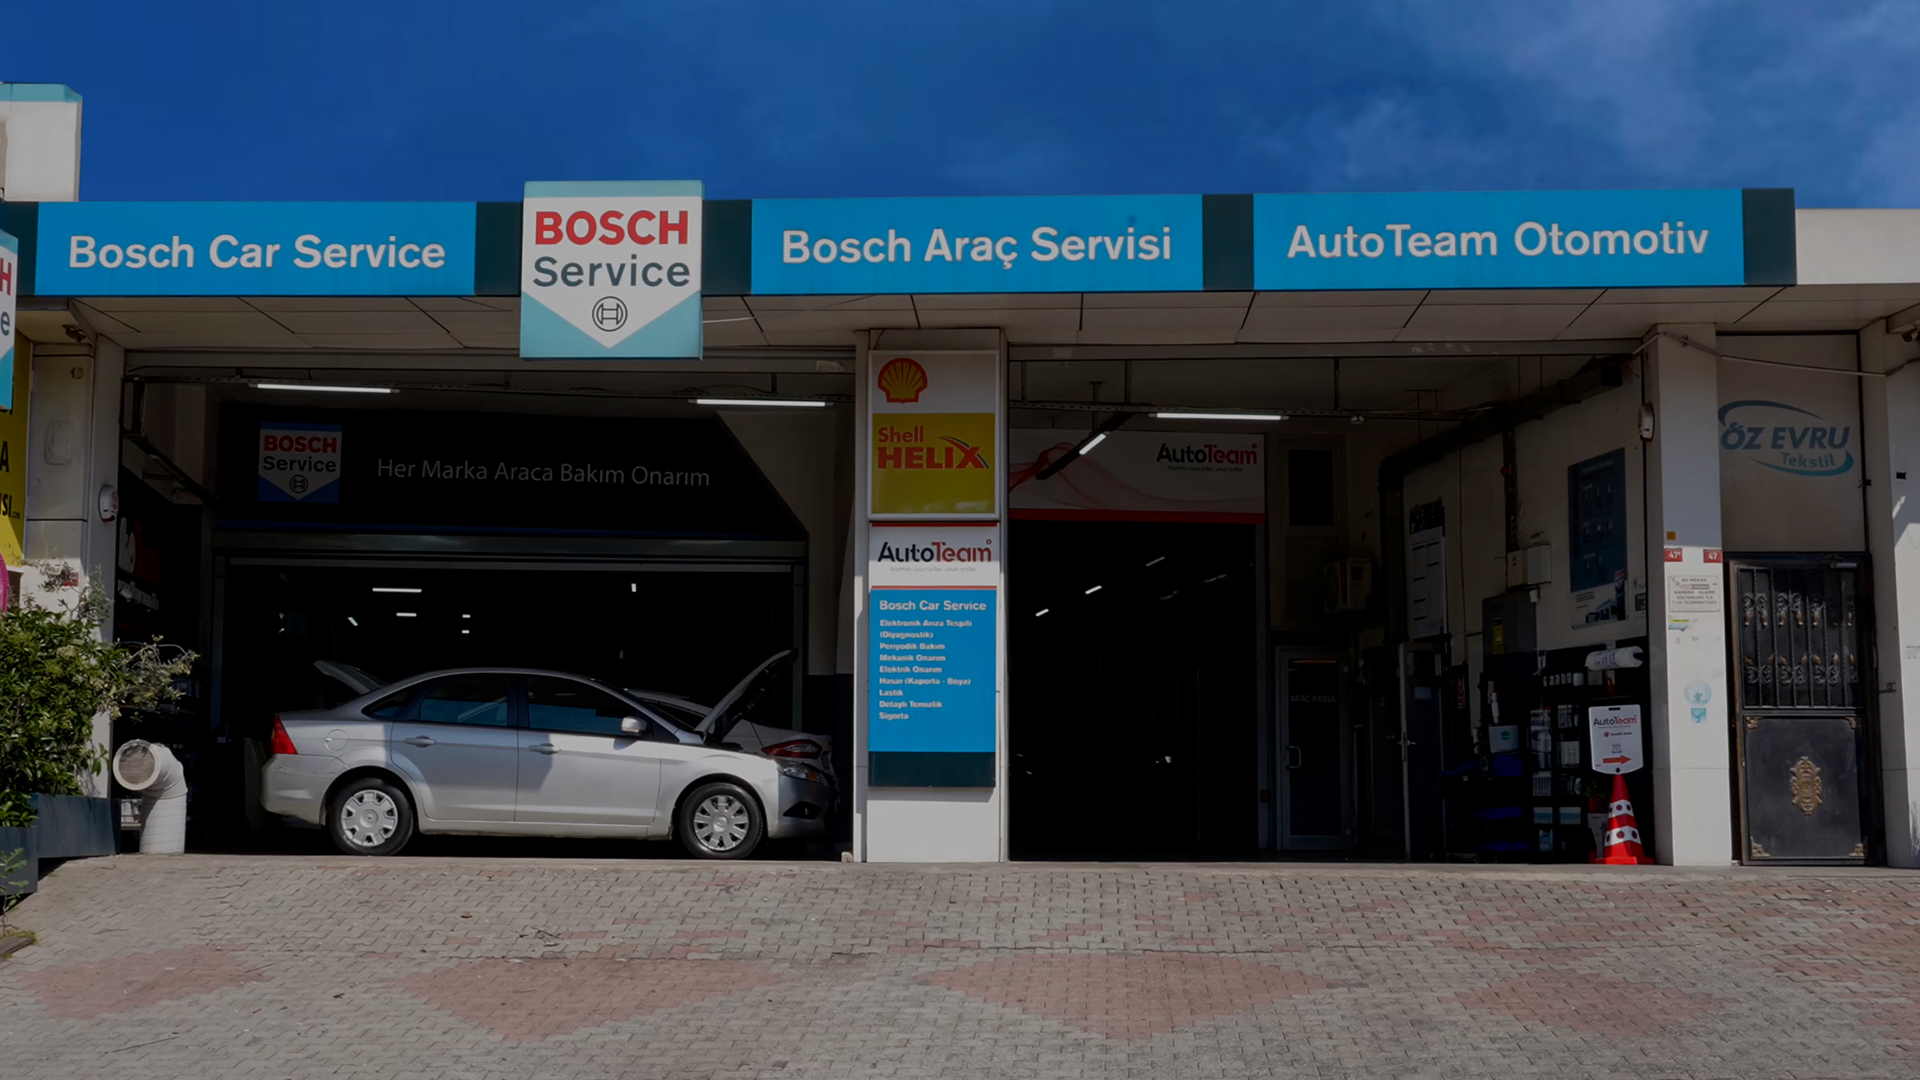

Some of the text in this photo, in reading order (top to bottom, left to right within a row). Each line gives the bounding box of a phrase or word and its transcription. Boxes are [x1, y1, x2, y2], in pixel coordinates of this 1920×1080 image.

[535, 210, 688, 245] BOSCH
[783, 226, 1171, 270] Bosch Araç Servisi
[1287, 220, 1710, 259] AutoTeam Otomotiv
[69, 234, 446, 269] Bosch Car Service
[533, 254, 690, 287] Service
[878, 426, 924, 443] Shell
[1721, 422, 1850, 450] ÖZ EVRU
[264, 435, 337, 453] BOSCH
[877, 446, 989, 469] HELIX
[1156, 443, 1257, 464] AutoTeam
[1781, 452, 1837, 468] Tekstil
[263, 455, 337, 473] Service
[378, 459, 710, 486] Her Marka Araca Bakım Onarım
[878, 540, 991, 562] AutoTeam
[1708, 552, 1718, 560] 47
[880, 600, 987, 611] Bosch Car Service
[880, 619, 972, 628] Elektronik Arıza Tespiti
[880, 631, 934, 640] (Diyagnostik)
[880, 642, 945, 651] Periyodik Bakım
[880, 654, 946, 662] Mekanik Onarım
[879, 677, 903, 685] Hasar
[904, 677, 941, 687] (Kaporta
[947, 677, 971, 686] Boya)
[879, 700, 943, 709] Detaylı Temizlik
[1290, 694, 1337, 704] ARAÇ KABUL
[879, 712, 909, 721] Sigorta
[1593, 715, 1637, 726] AutoTeam
